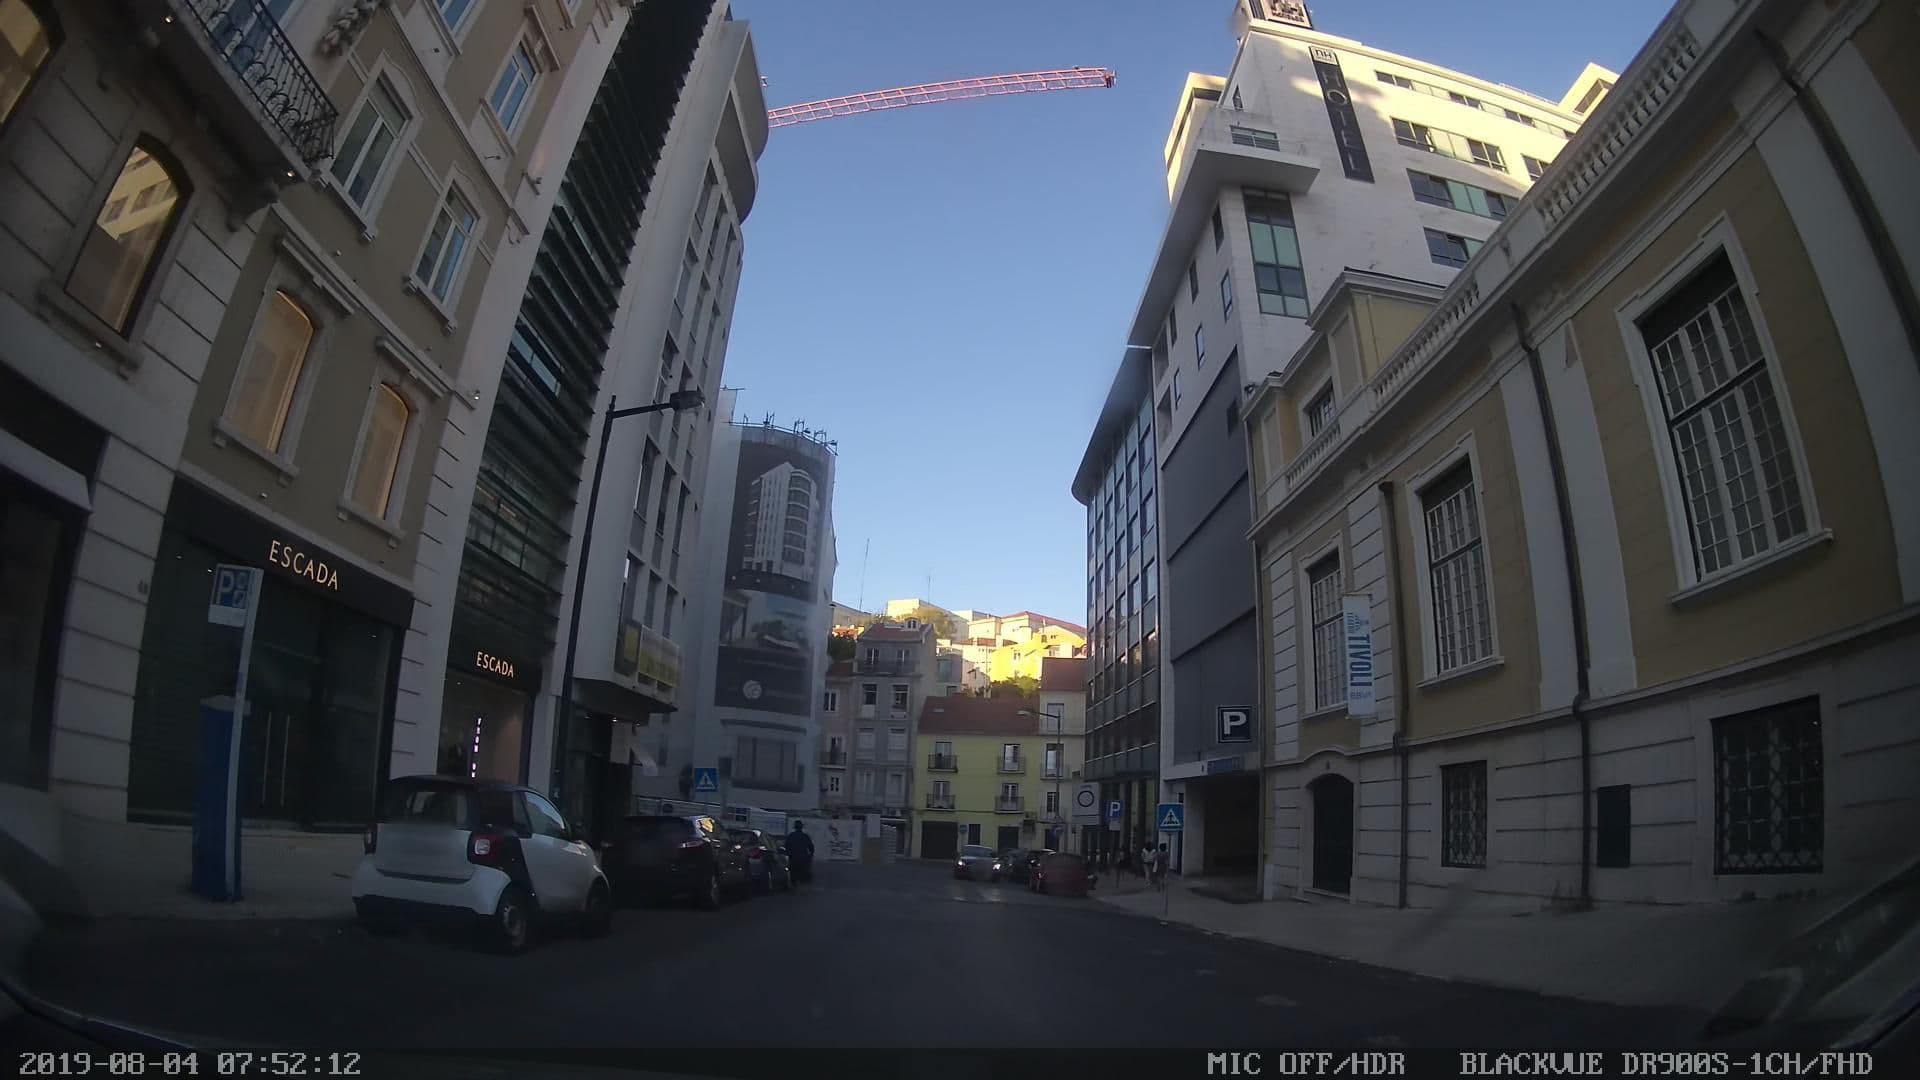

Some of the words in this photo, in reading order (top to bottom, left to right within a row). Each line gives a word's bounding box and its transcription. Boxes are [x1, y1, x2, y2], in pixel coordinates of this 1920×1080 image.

[270, 540, 338, 590] ESCADA
[477, 651, 514, 679] ESCADA
[1348, 633, 1373, 687] TIVOLI
[1223, 711, 1247, 734] P
[1110, 801, 1121, 817] P
